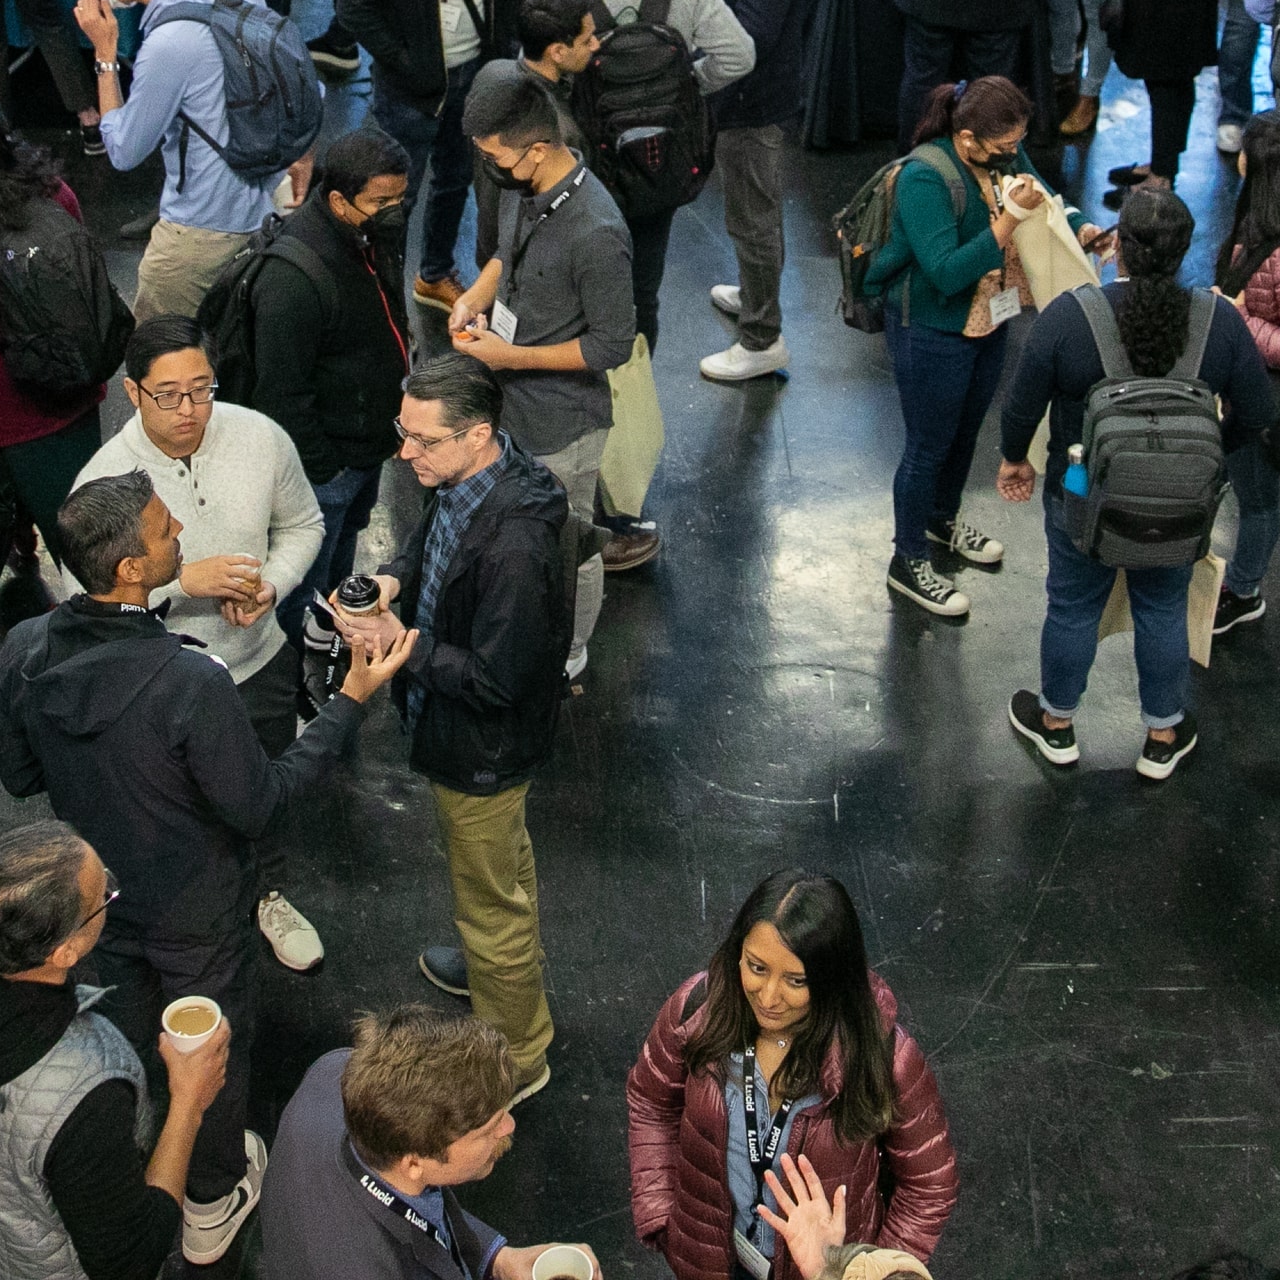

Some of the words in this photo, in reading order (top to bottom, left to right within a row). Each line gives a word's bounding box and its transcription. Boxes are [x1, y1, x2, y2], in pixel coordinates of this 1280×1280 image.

[745, 1084, 755, 1111] Lucid
[749, 1137, 760, 1162] Lucid
[768, 1126, 781, 1151] Lucid
[366, 1180, 395, 1207] Lucid
[411, 1212, 428, 1232] Lucid
